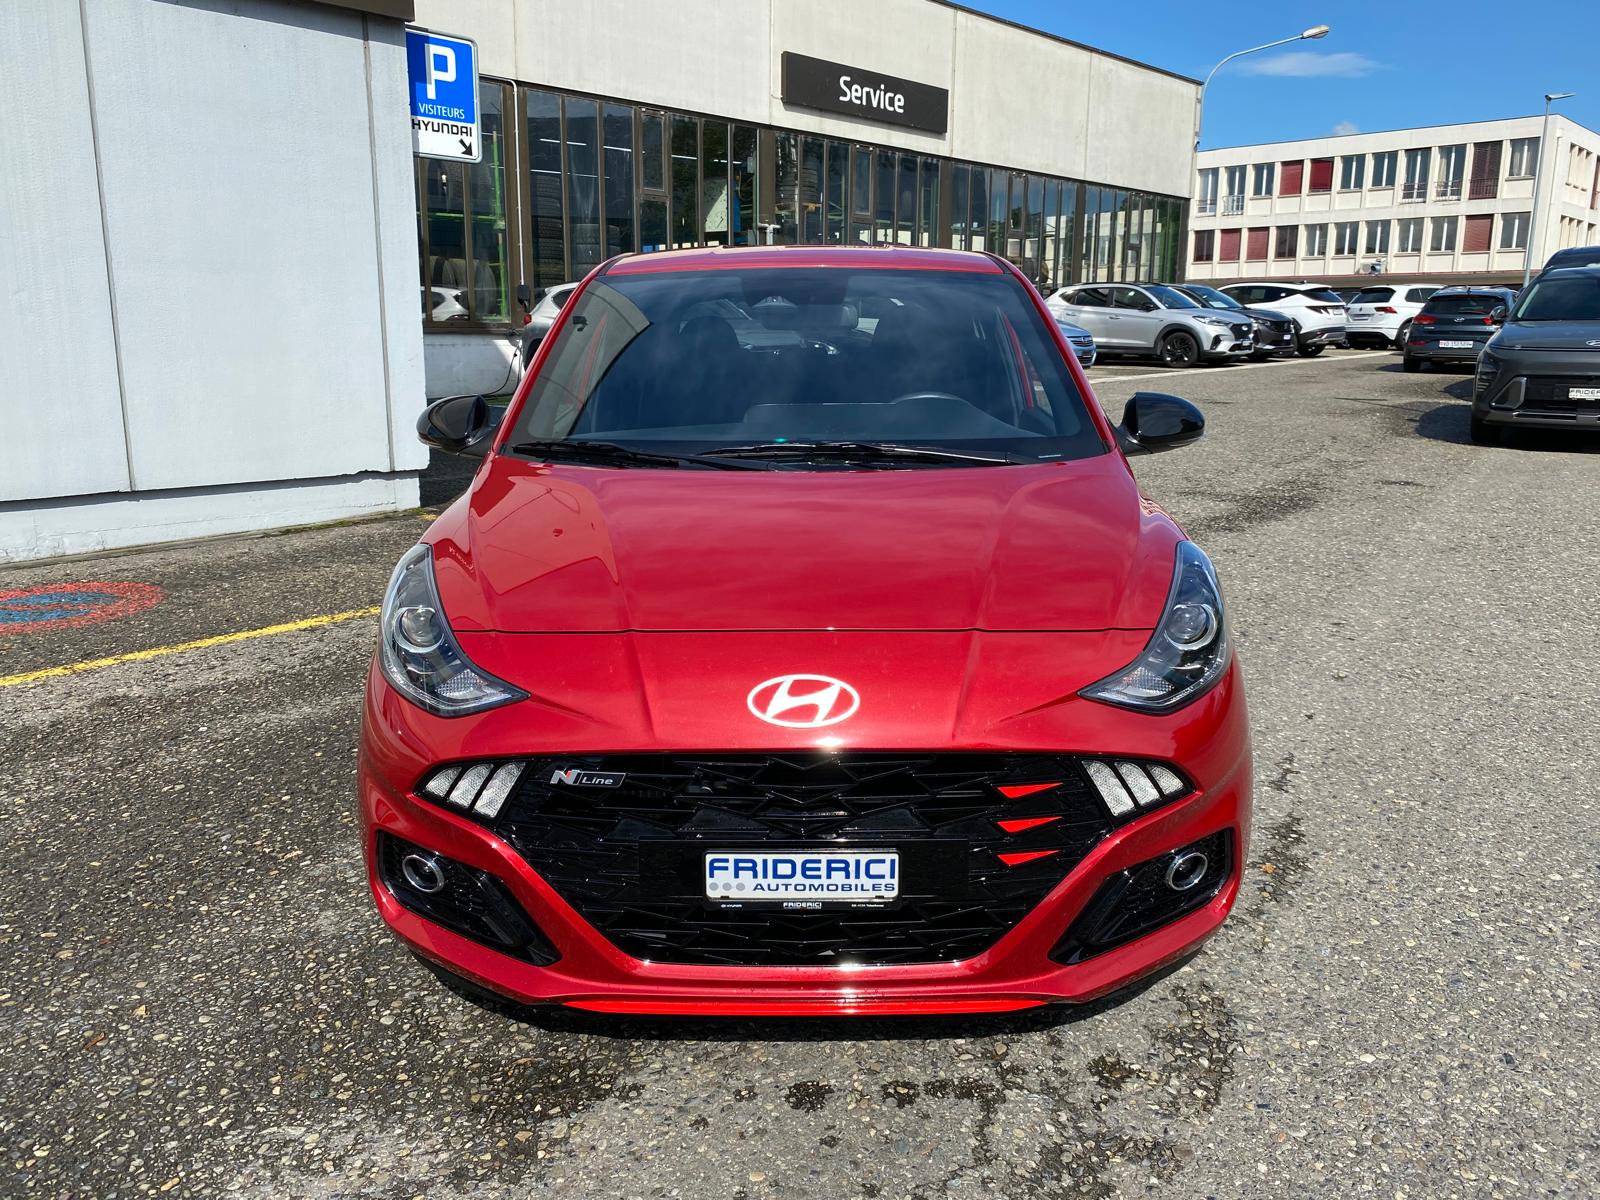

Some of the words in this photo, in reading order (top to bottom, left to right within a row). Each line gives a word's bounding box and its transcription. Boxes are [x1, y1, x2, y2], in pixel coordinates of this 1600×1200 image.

[424, 43, 456, 100] P
[839, 75, 905, 113] Service
[418, 102, 465, 119] VISITEURS
[411, 118, 472, 137] HYUNDAI
[581, 776, 614, 785] Line
[708, 858, 896, 880] FRIDERICI
[752, 883, 896, 892] AUTOMOBILES
